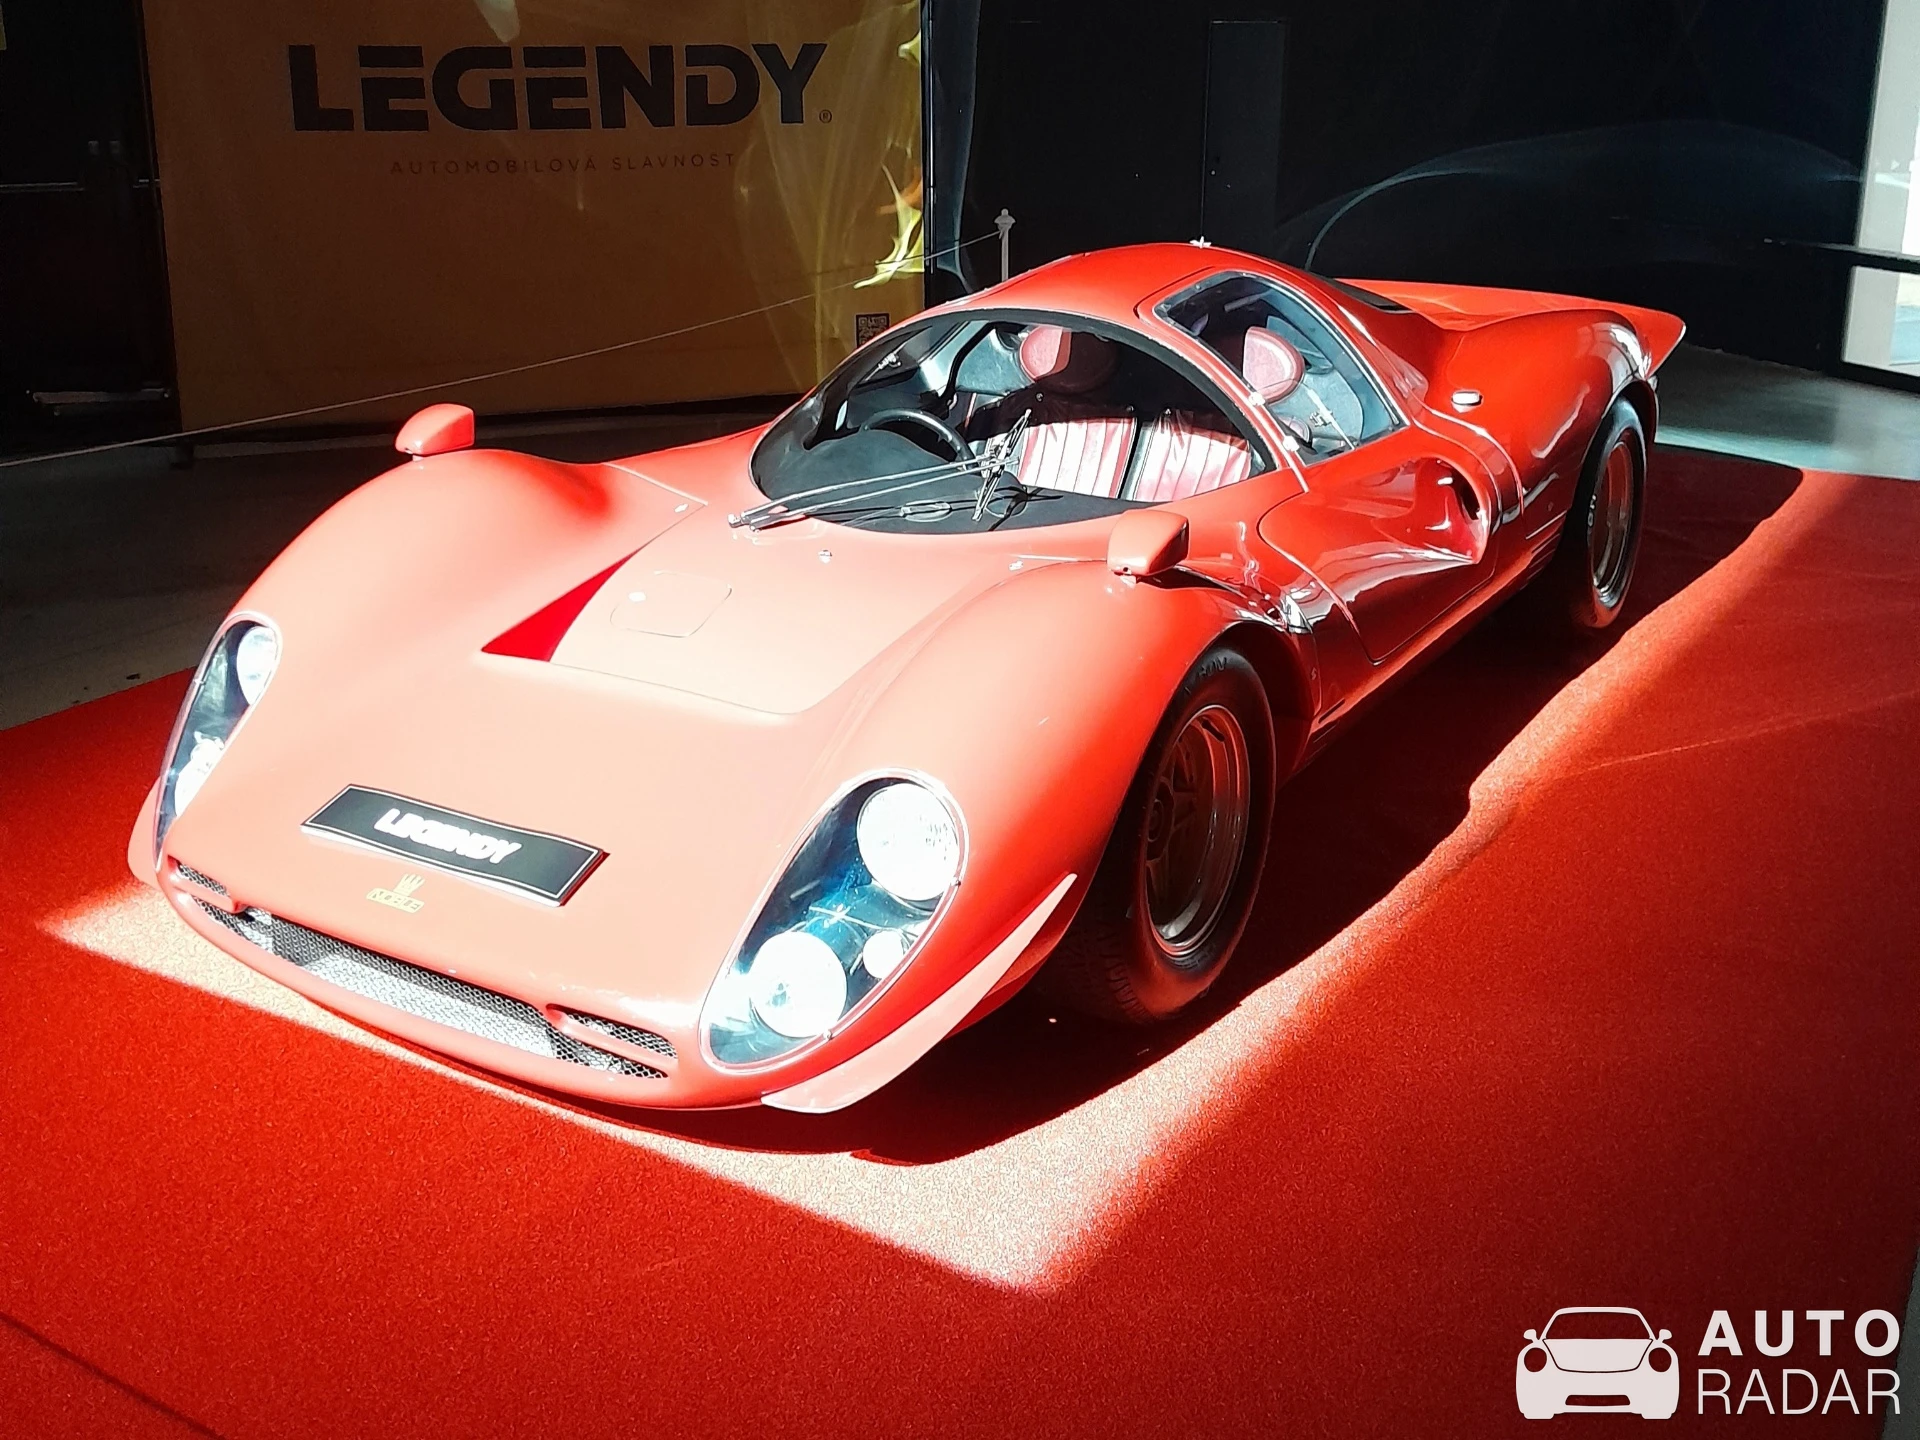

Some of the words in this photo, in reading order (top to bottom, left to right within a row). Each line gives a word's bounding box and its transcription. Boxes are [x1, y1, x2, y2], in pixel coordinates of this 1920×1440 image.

[288, 43, 827, 131] LEGENDY
[390, 155, 597, 175] AUTOMOBILOVÁ
[611, 153, 735, 171] SLAVNOST
